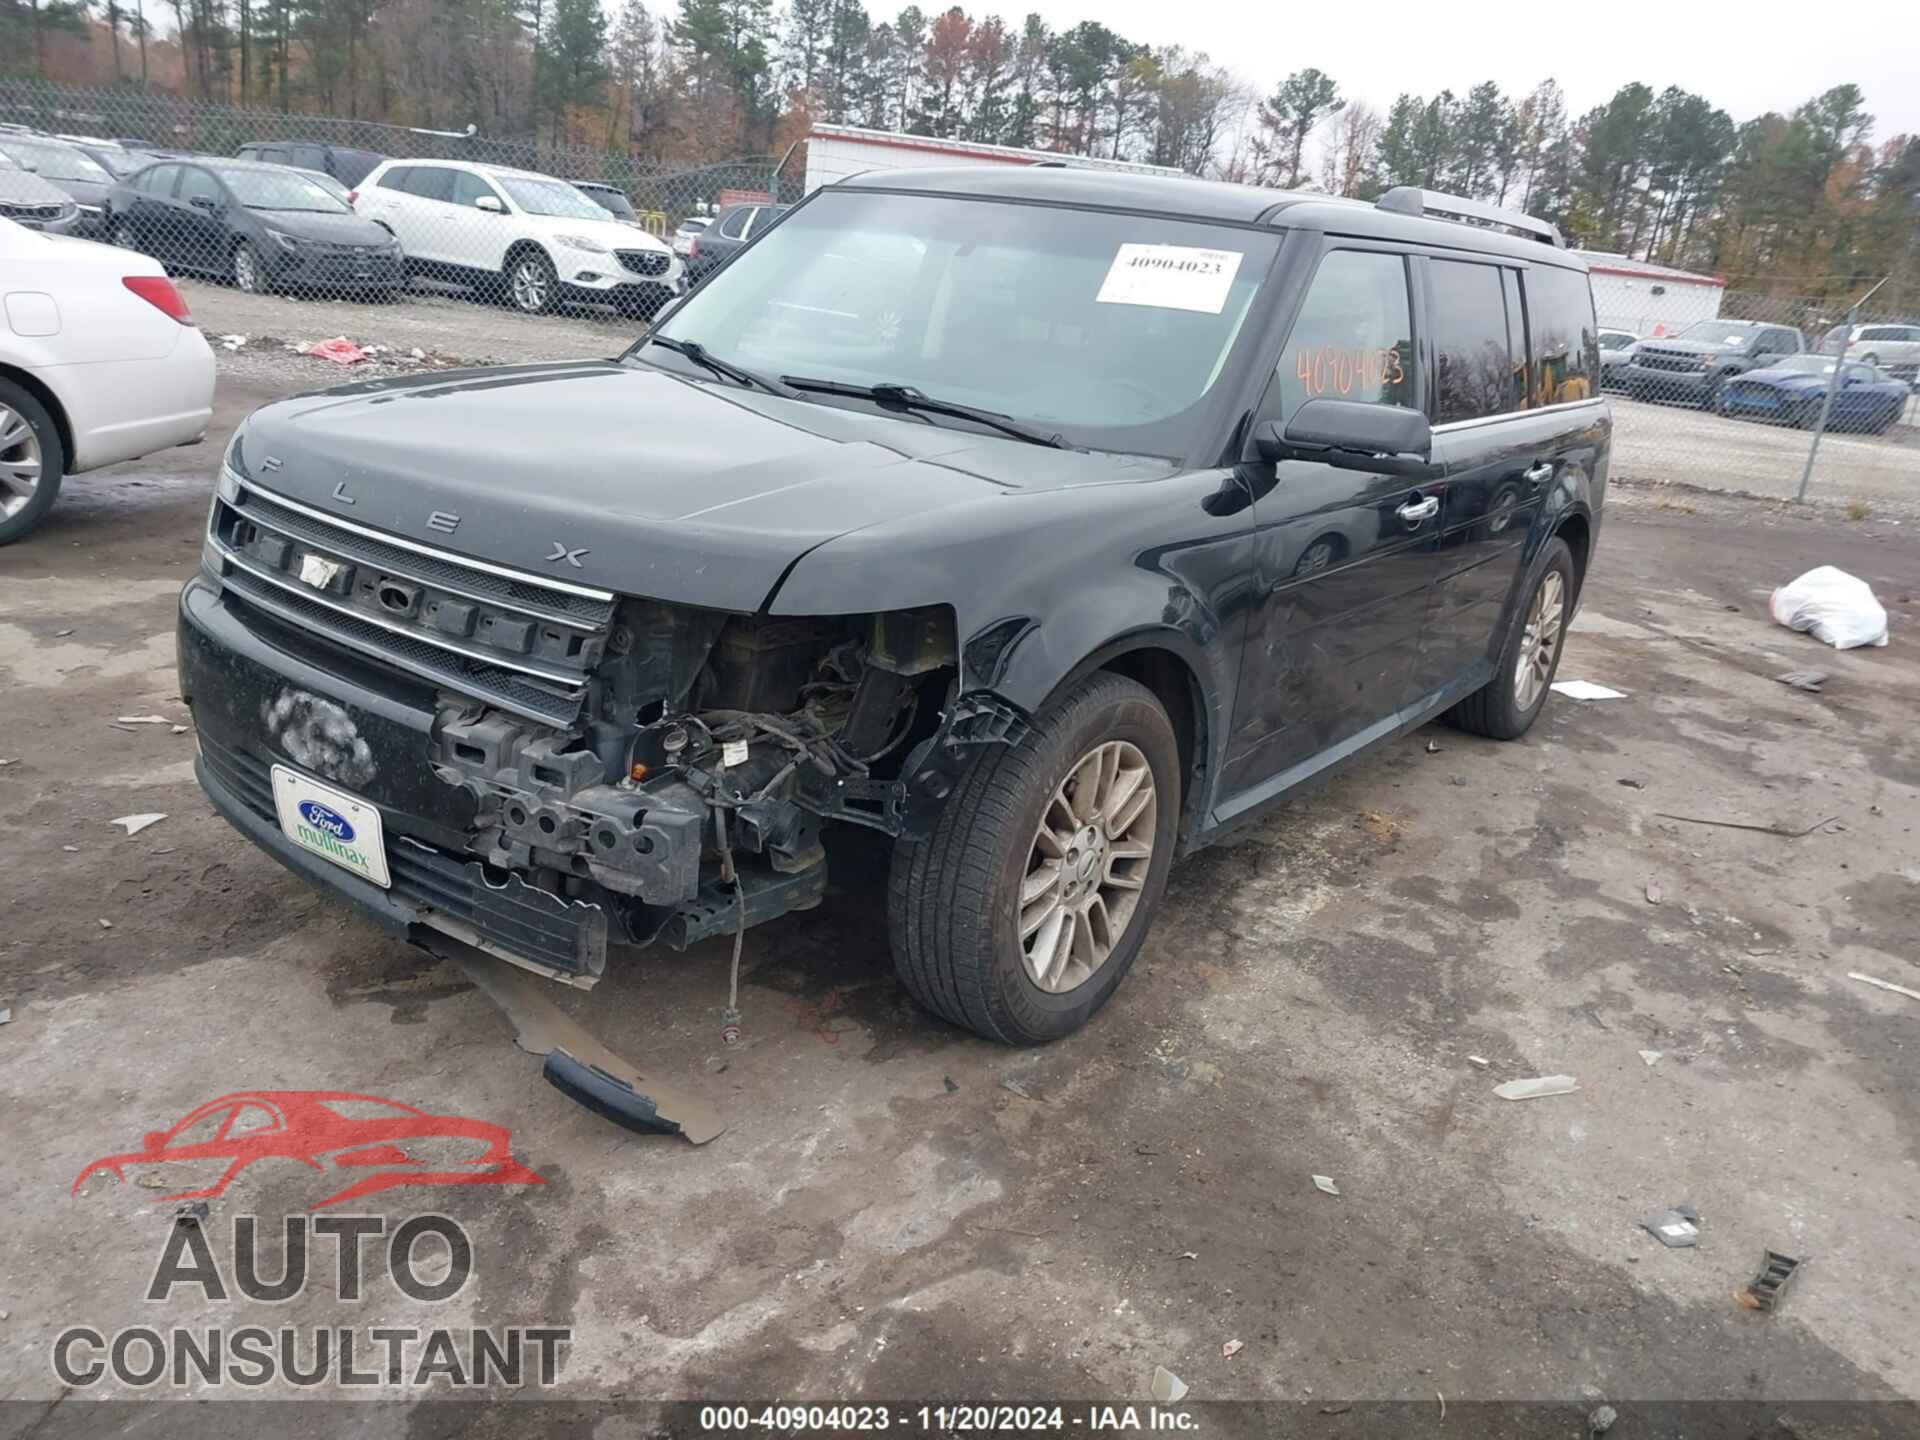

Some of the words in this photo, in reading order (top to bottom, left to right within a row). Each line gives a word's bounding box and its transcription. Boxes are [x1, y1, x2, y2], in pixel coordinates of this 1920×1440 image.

[1127, 256, 1223, 275] 40904023
[1297, 350, 1405, 396] 40904023
[259, 455, 591, 569] FLEX
[308, 804, 345, 837] Ford
